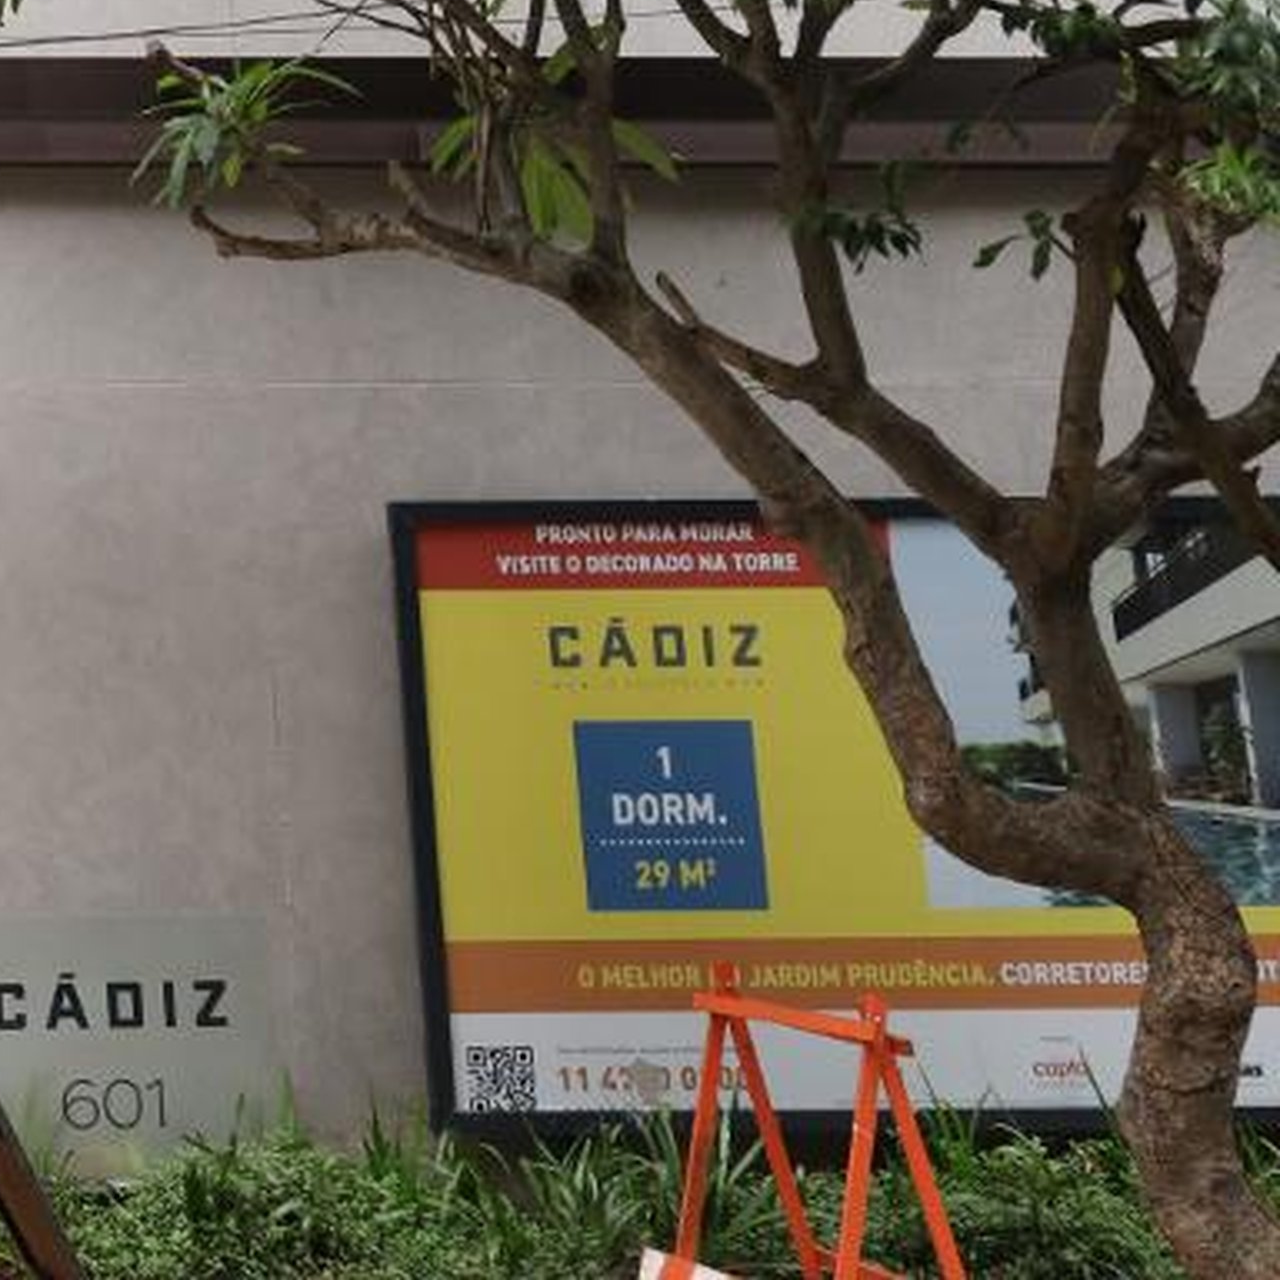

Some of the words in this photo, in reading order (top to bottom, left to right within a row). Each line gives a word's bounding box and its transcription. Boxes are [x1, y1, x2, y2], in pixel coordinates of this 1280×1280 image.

[536, 524, 617, 543] PRONTO
[622, 523, 676, 542] PARA
[680, 522, 753, 542] MORAR
[496, 554, 560, 574] VISITE
[566, 555, 581, 573] O
[585, 553, 693, 573] DECORADO
[699, 553, 727, 572] NA
[732, 552, 799, 572] TORRE
[656, 746, 672, 779] 1
[612, 792, 727, 825] DORM.
[635, 860, 670, 890] 29
[578, 964, 593, 988] O
[602, 963, 702, 988] MELHOR
[749, 963, 840, 987] JARDIM
[847, 959, 994, 987] PRUDÊNCIA.
[560, 1066, 588, 1091] 11
[62, 1078, 166, 1130] 601
